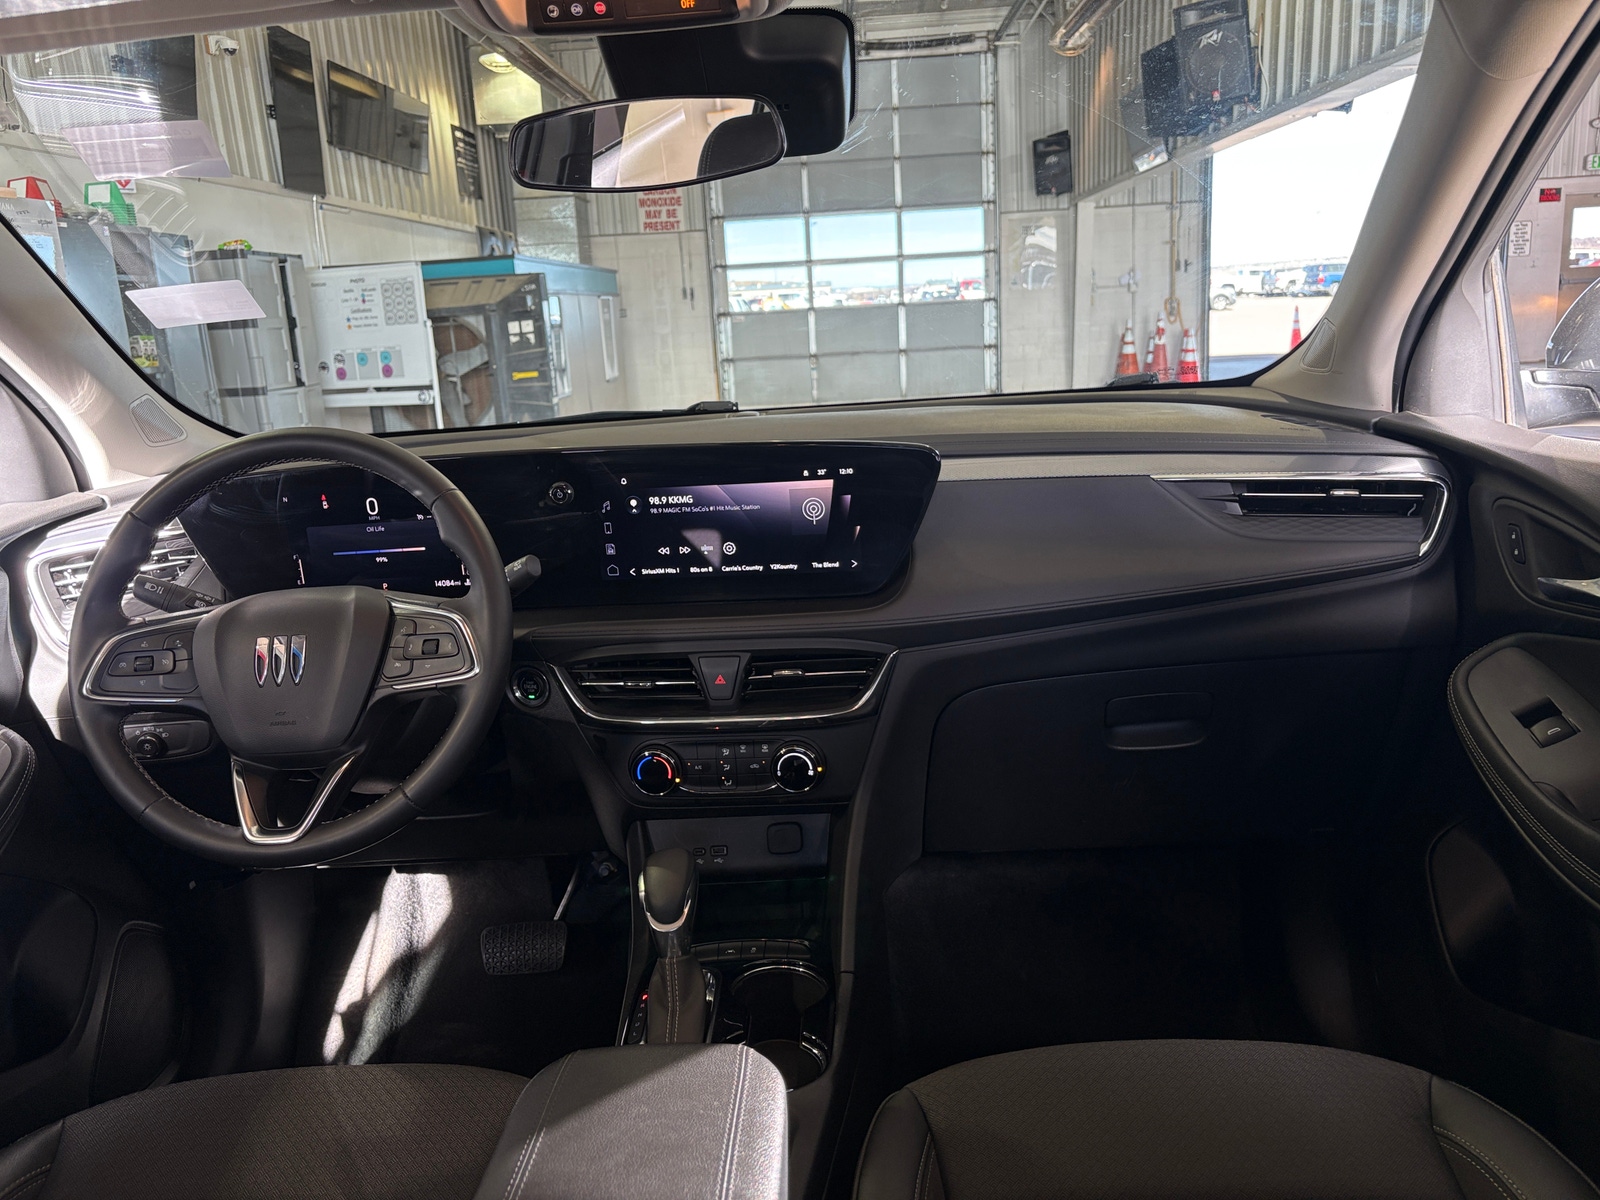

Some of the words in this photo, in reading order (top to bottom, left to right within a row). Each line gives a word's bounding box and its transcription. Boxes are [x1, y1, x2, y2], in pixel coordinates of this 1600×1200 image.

[680, 0, 696, 8] OFF
[638, 196, 682, 208] MONOXIDE
[645, 209, 662, 219] MAY
[666, 208, 678, 218] BE
[643, 220, 681, 232] PRESENT
[648, 496, 667, 505] 98.9
[668, 495, 693, 504] KKMG
[366, 497, 379, 515] 0
